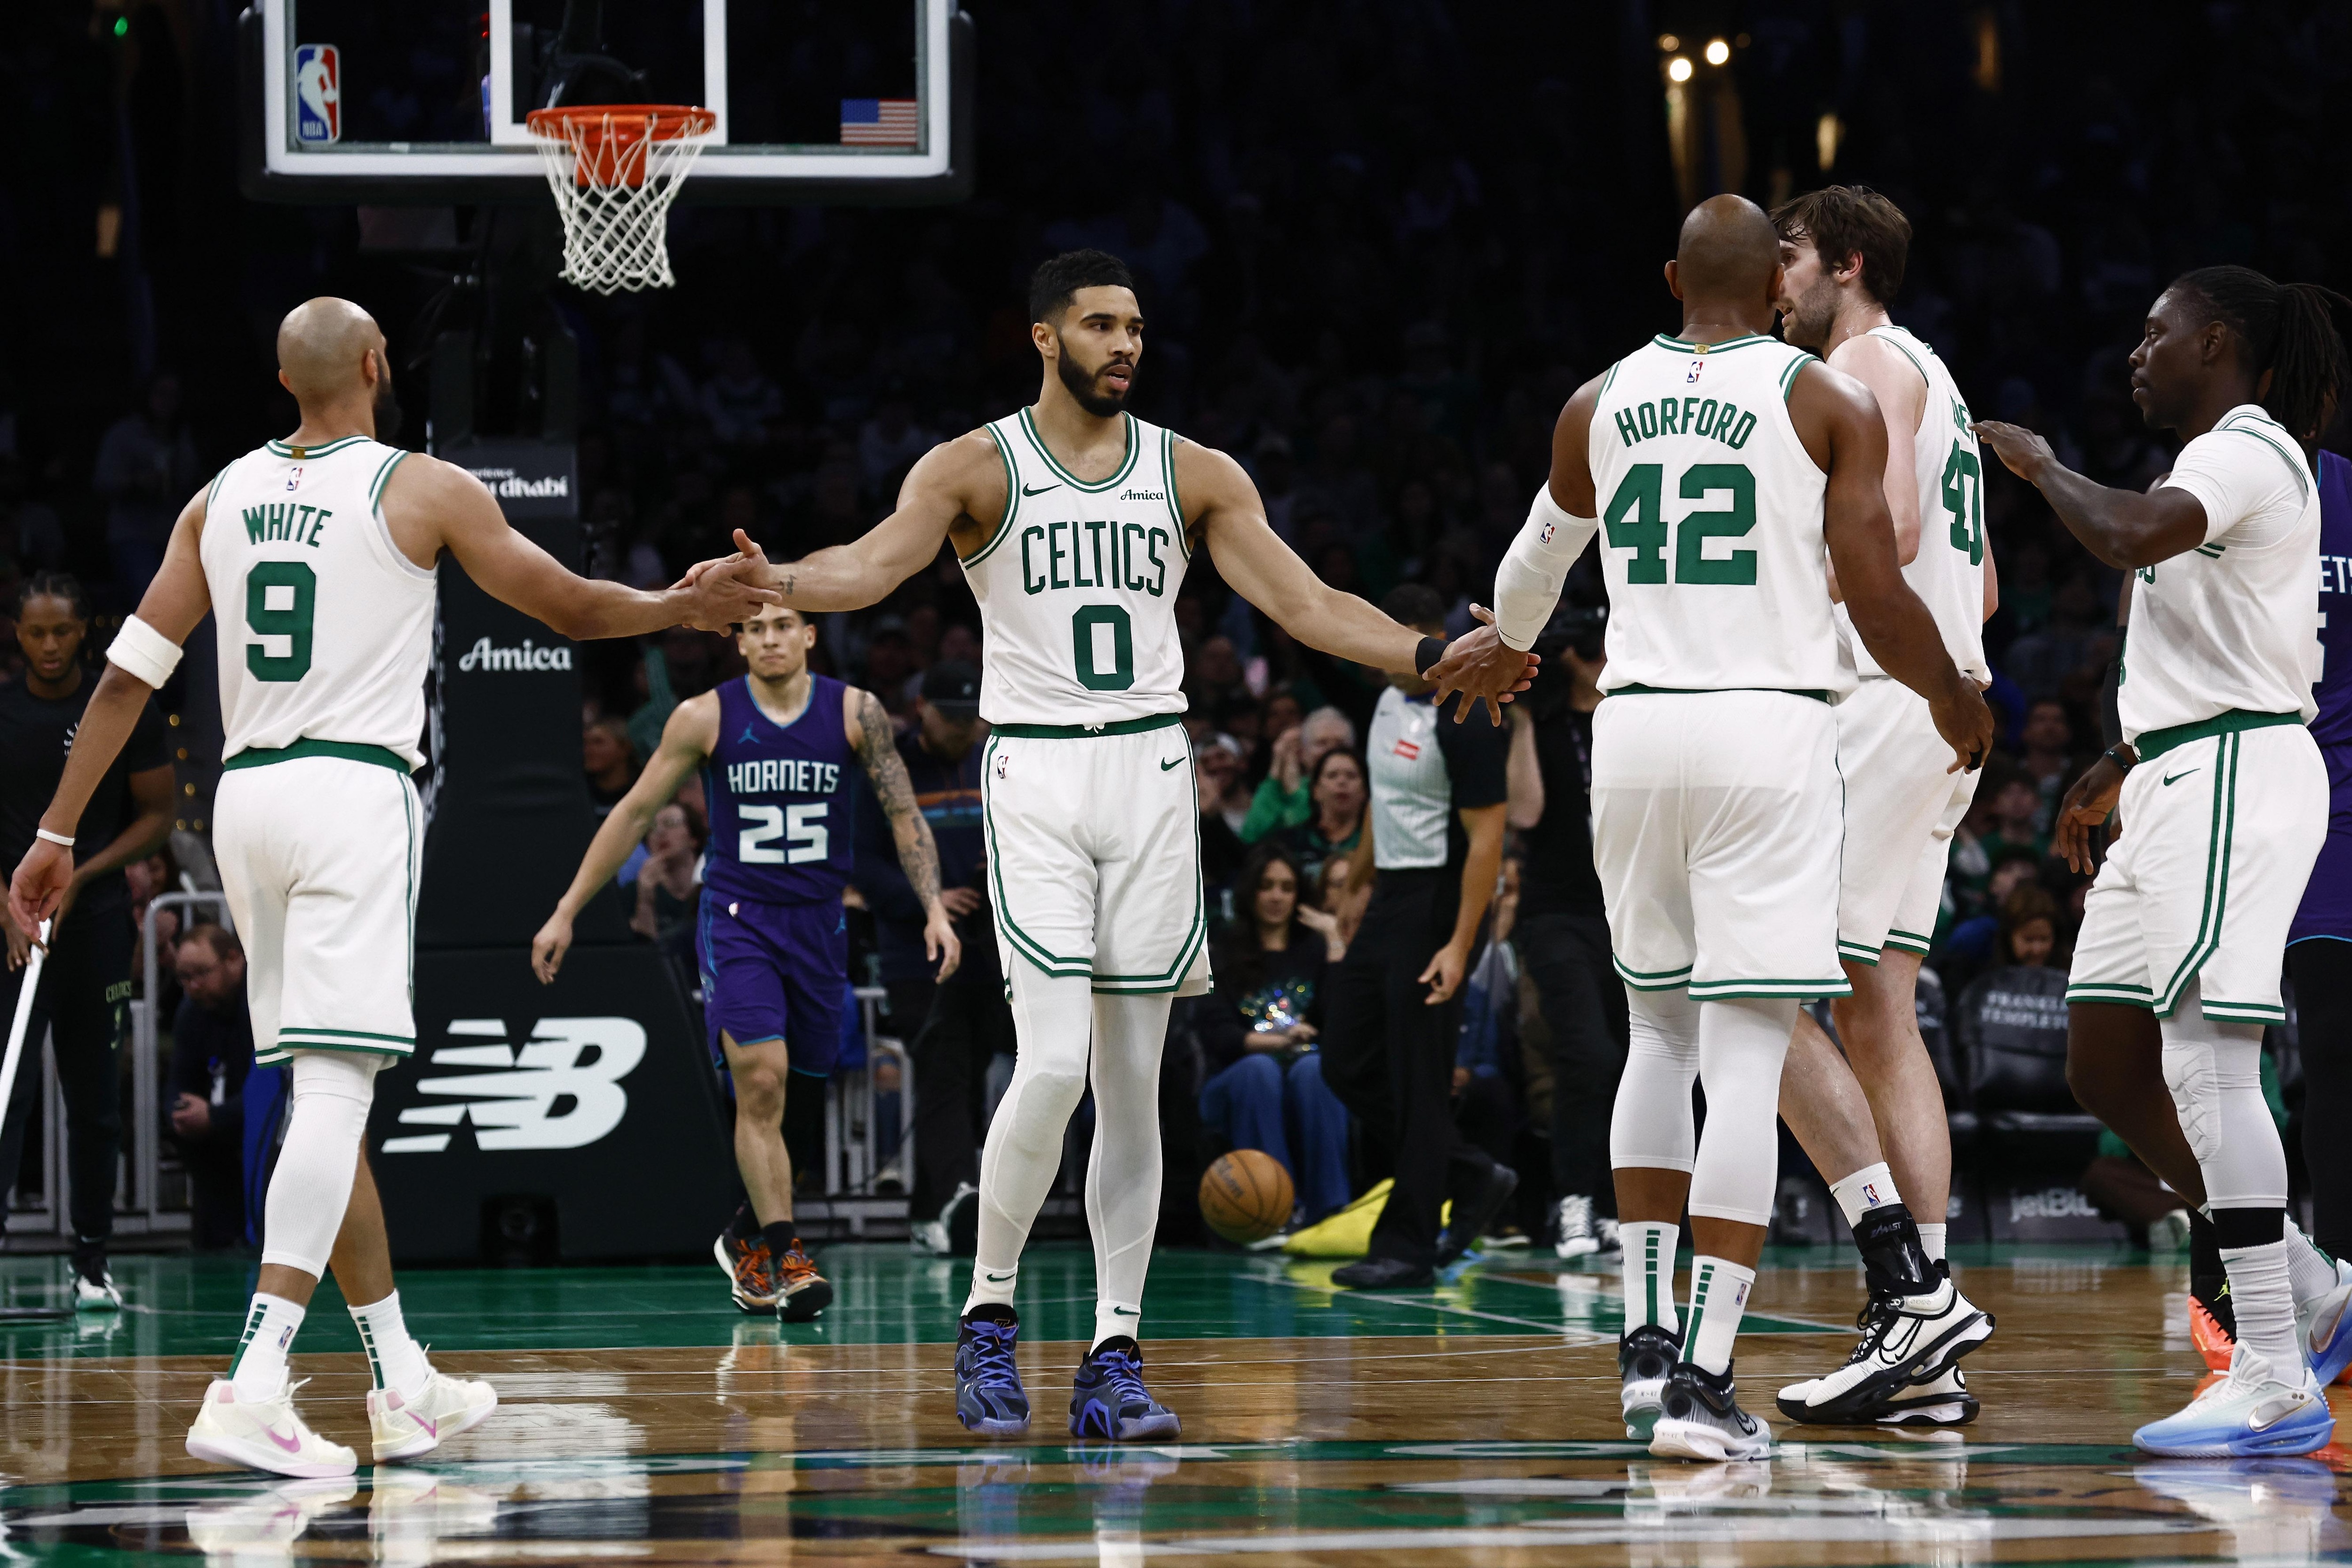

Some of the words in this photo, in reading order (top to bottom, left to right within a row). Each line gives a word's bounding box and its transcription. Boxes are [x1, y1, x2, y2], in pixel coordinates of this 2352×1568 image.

[302, 121, 323, 137] NBA
[1615, 398, 1756, 449] HORFORD
[498, 476, 568, 498] dhabi
[1120, 489, 1164, 500] Amica
[243, 504, 332, 547] WHITE
[1604, 463, 1756, 585] 42
[1022, 521, 1168, 597] CELTICS
[246, 562, 316, 682] 9
[459, 637, 572, 672] Amica
[1073, 605, 1134, 691] 0
[727, 759, 840, 794] HORNETS
[738, 802, 829, 864] 25
